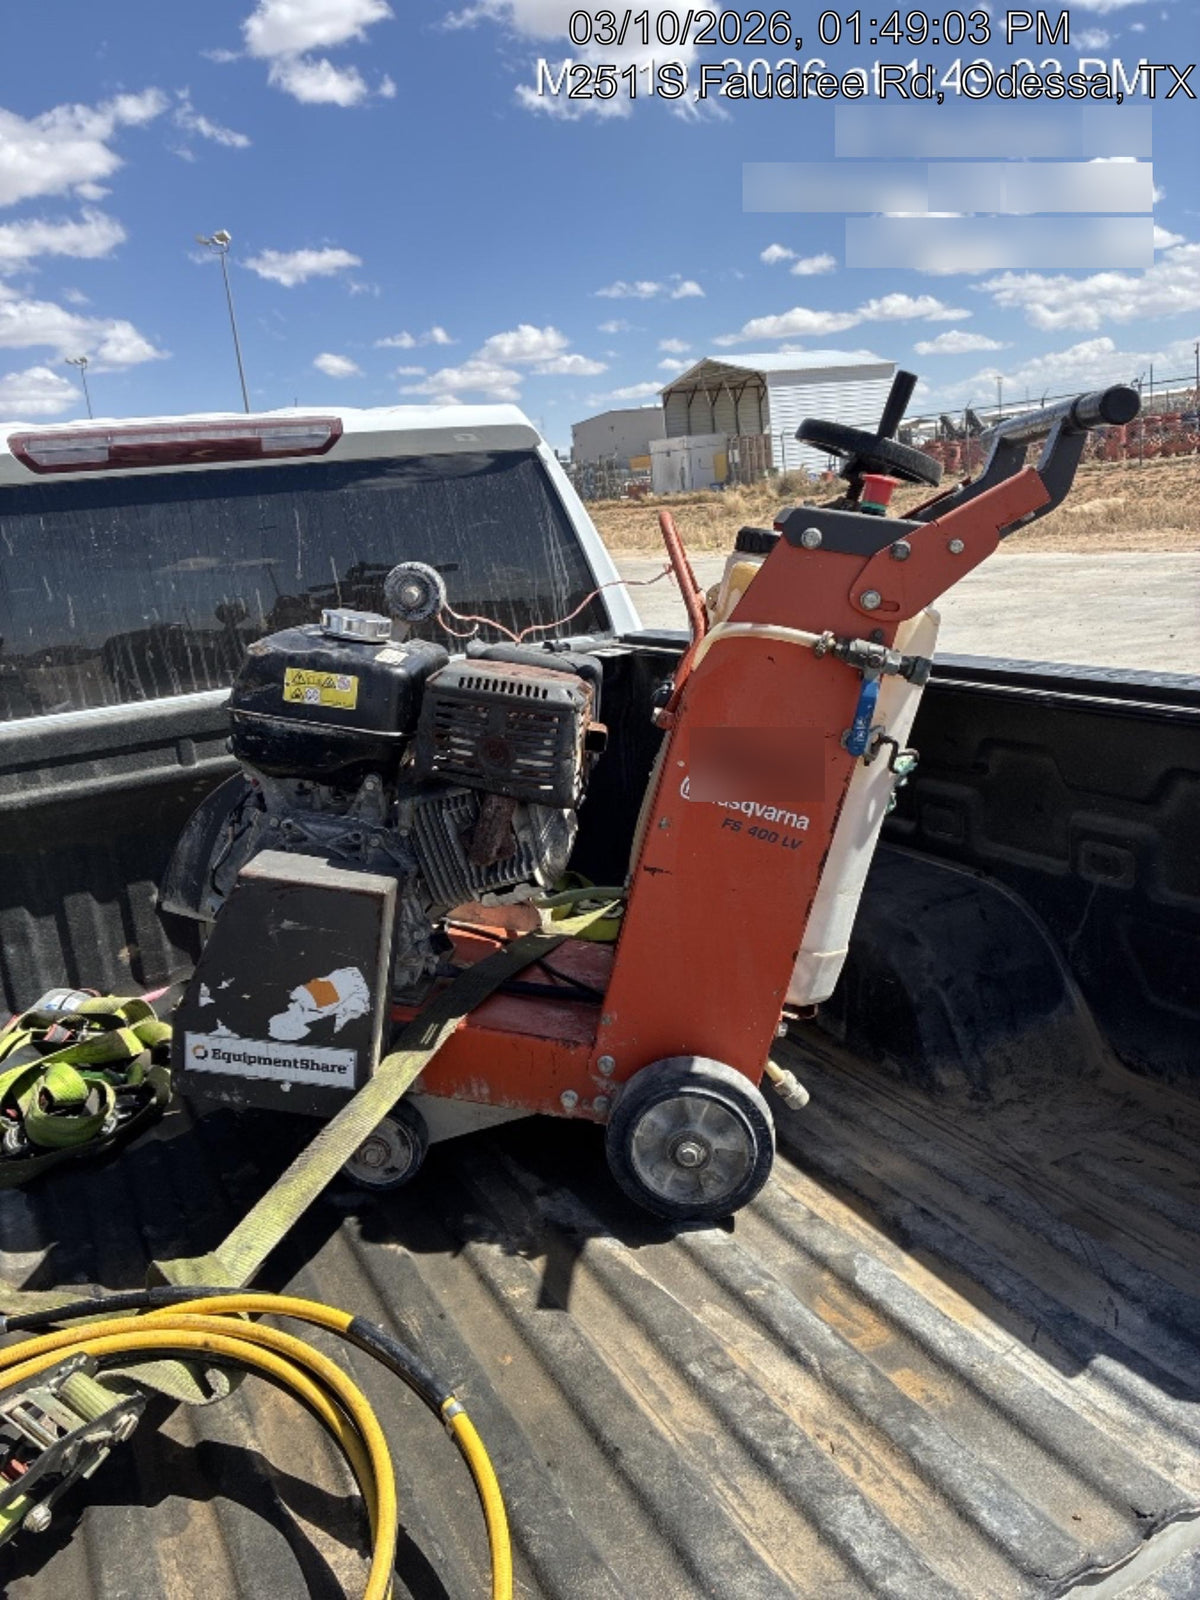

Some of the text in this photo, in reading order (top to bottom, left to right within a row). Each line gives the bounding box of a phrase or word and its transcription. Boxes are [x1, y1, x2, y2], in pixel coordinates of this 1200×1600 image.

[721, 818, 803, 850] FS 400 LV
[211, 1048, 348, 1074] EquipmentShare
